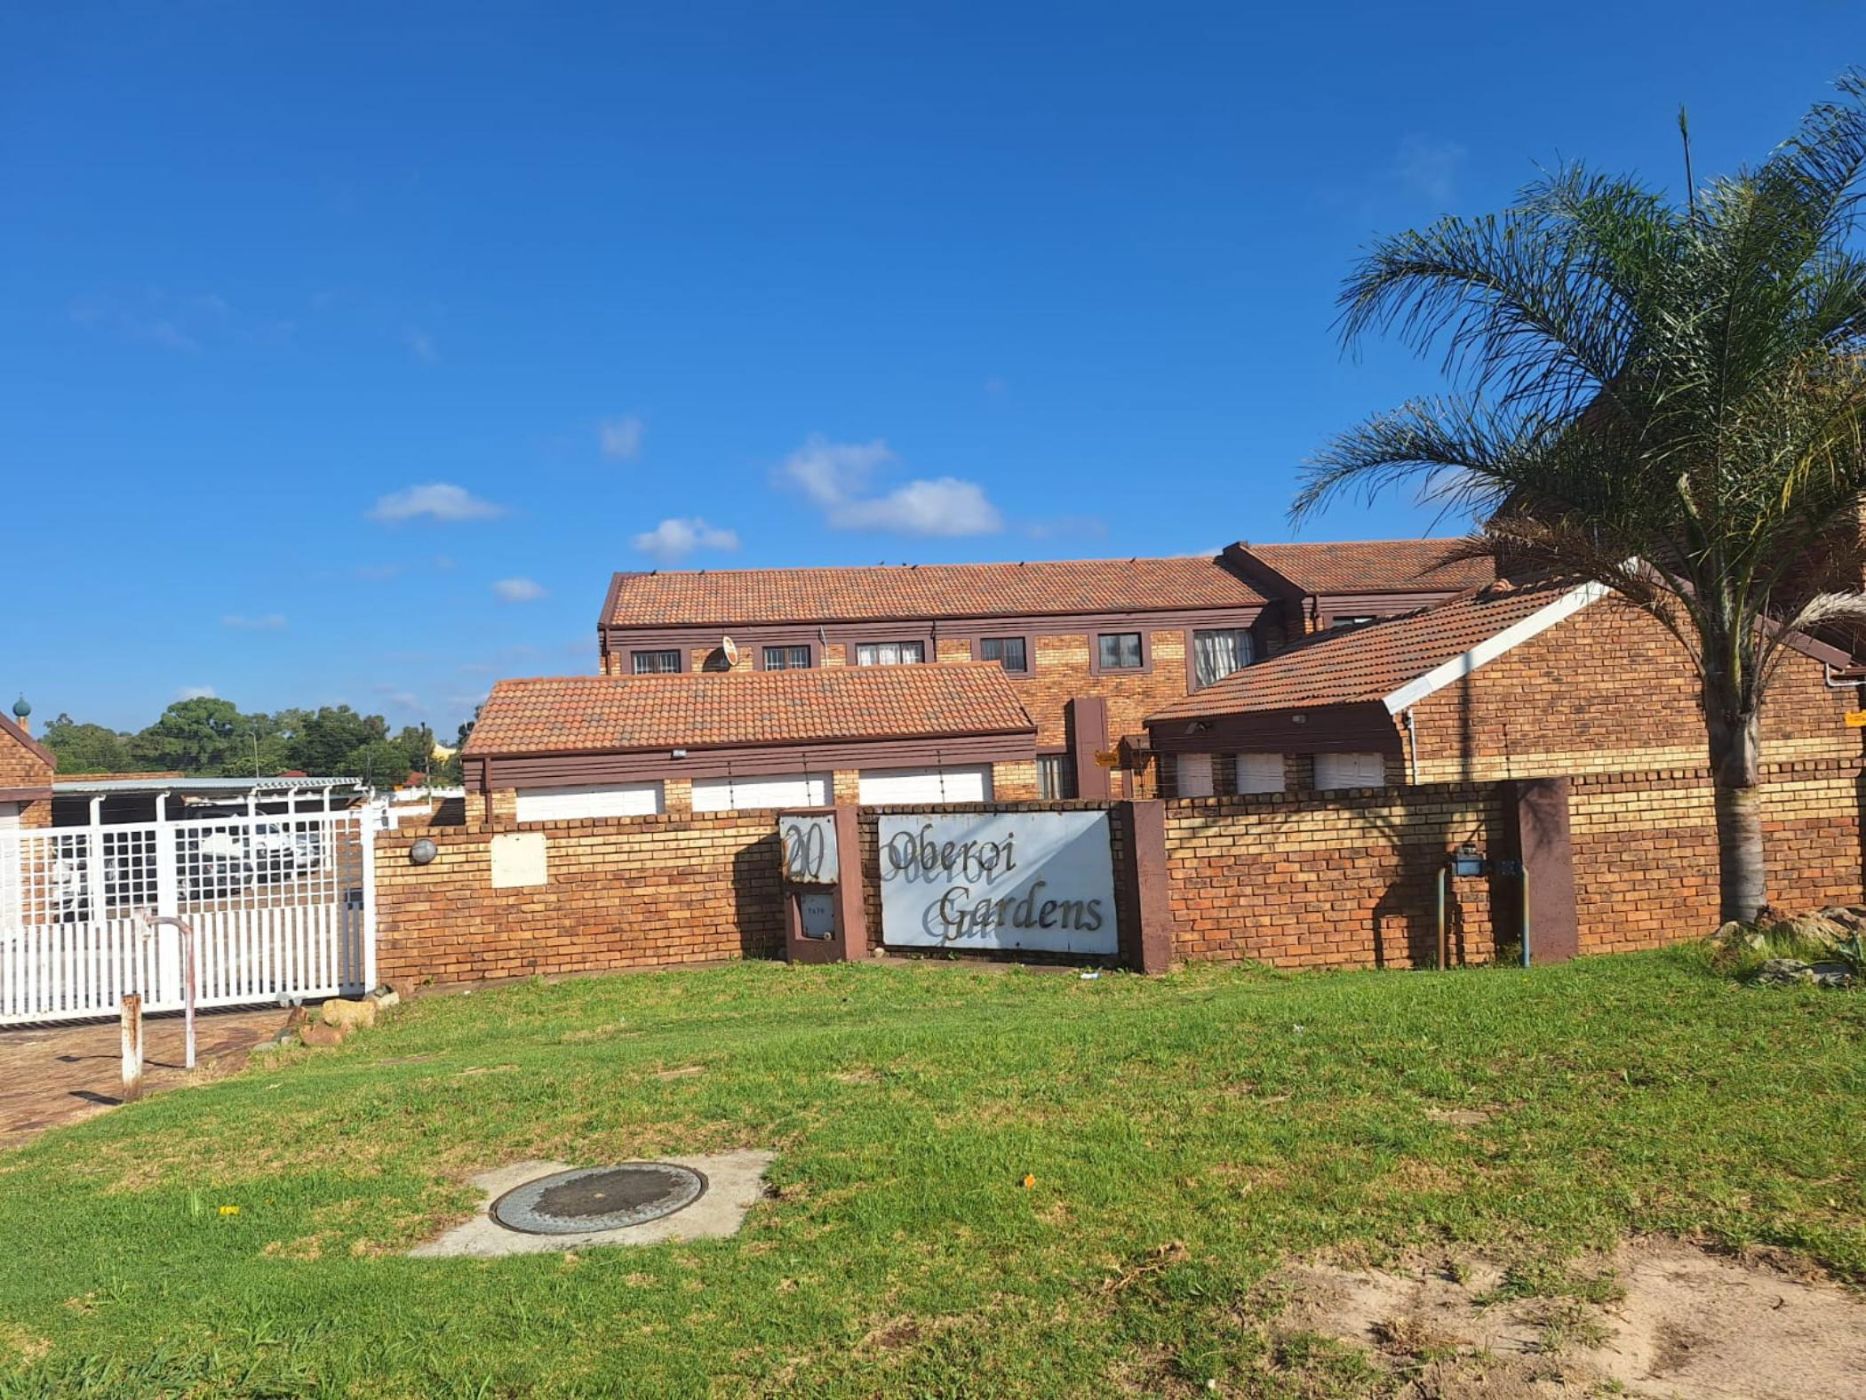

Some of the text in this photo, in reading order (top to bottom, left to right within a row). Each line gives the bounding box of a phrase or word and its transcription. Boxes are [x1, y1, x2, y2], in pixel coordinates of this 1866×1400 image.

[785, 823, 824, 879] 20
[889, 824, 1016, 872] Oberoi
[940, 882, 1102, 941] Gardens
